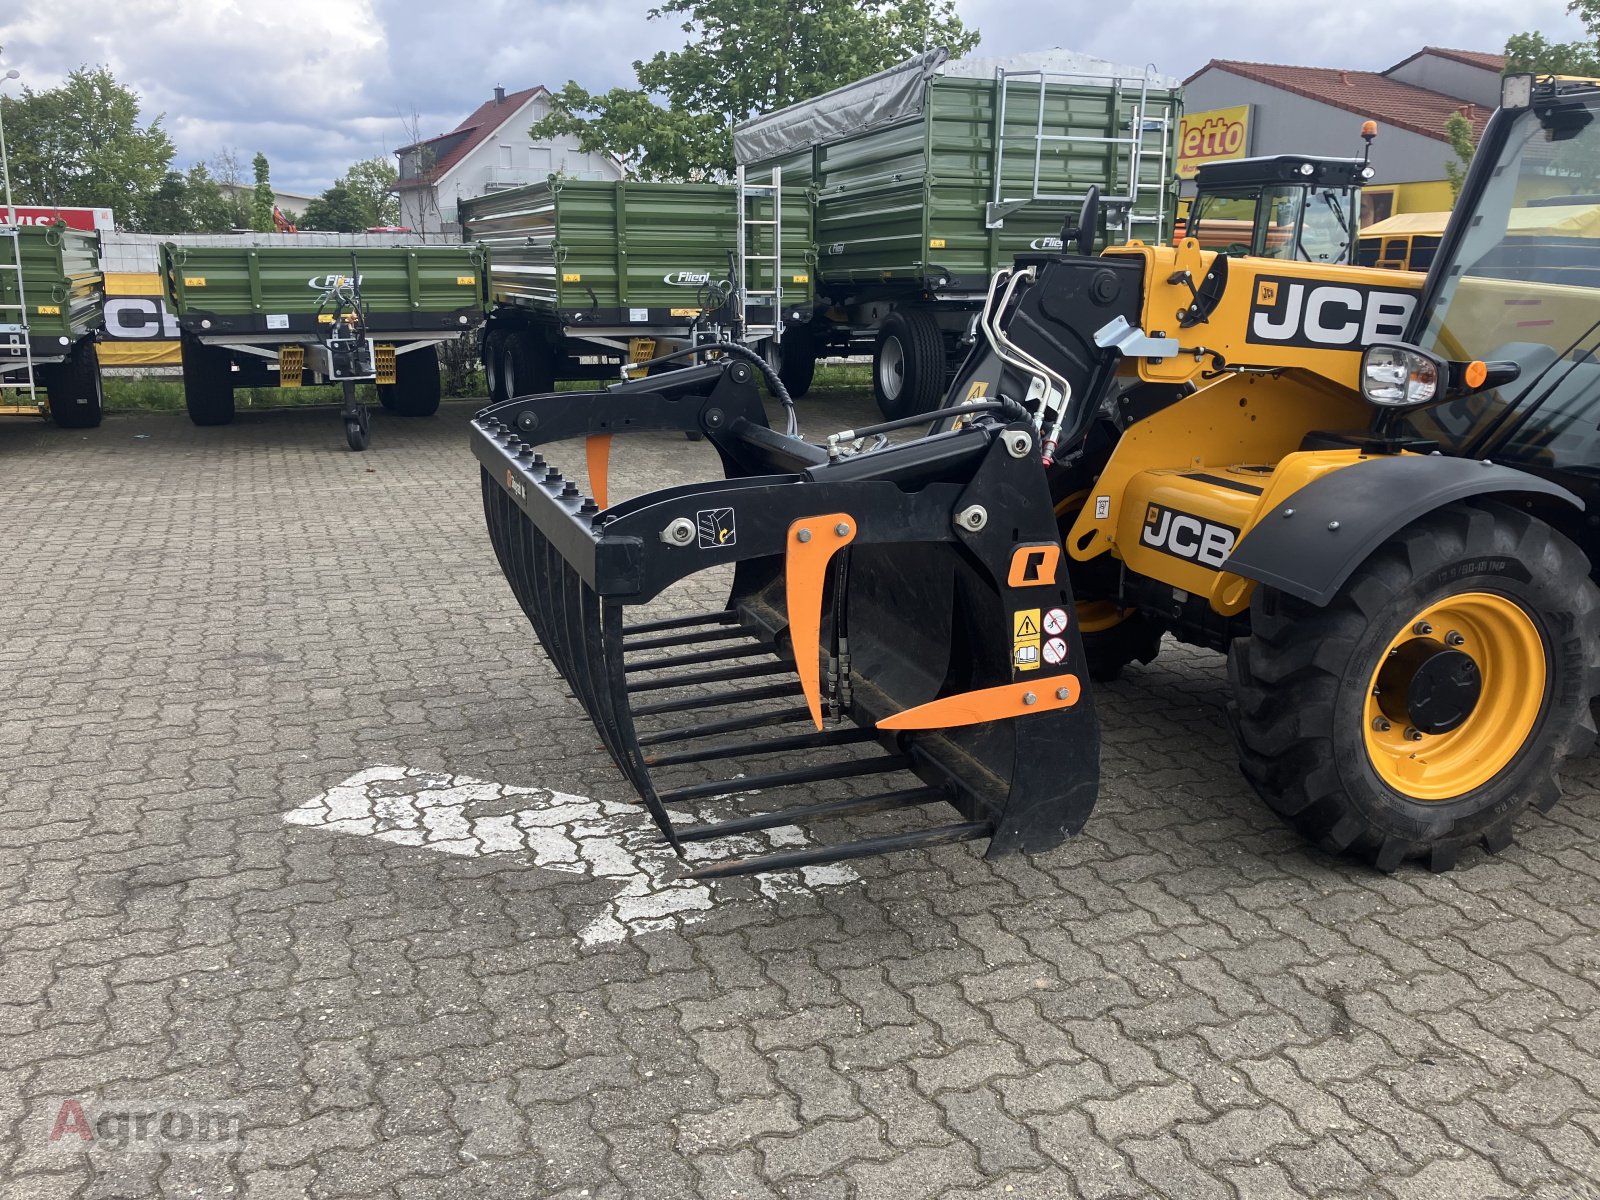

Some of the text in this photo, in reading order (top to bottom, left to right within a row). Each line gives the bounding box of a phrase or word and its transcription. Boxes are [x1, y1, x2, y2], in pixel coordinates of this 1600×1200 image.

[678, 271, 710, 284] Fliegl
[1253, 283, 1418, 346] JCB
[1143, 510, 1235, 568] JCB
